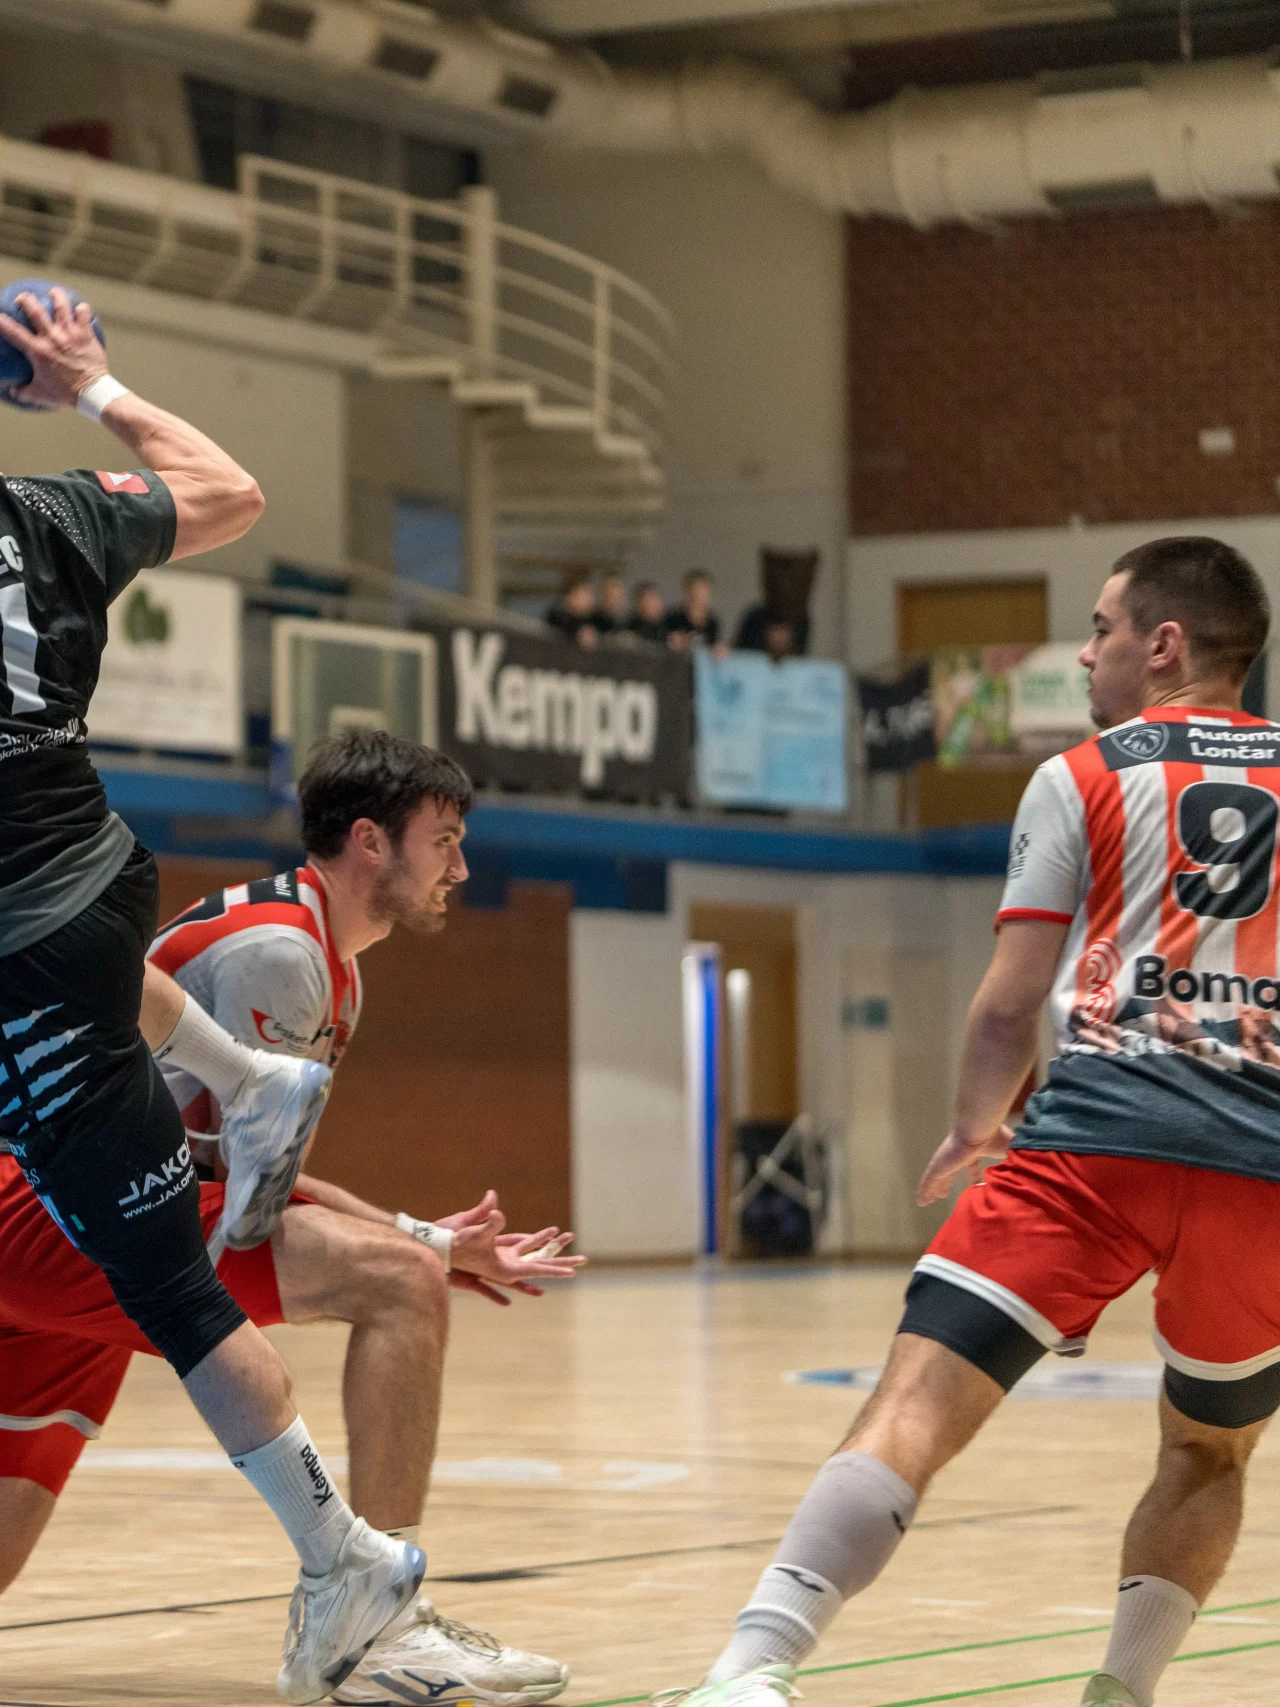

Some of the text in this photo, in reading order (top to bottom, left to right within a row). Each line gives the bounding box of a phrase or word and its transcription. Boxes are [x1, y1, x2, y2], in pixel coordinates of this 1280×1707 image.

[1190, 741, 1276, 760] Lončar
[1174, 781, 1280, 920] 9
[1135, 955, 1280, 1012] Boma
[118, 1136, 191, 1206] JAKO
[300, 1443, 334, 1507] Kempa
